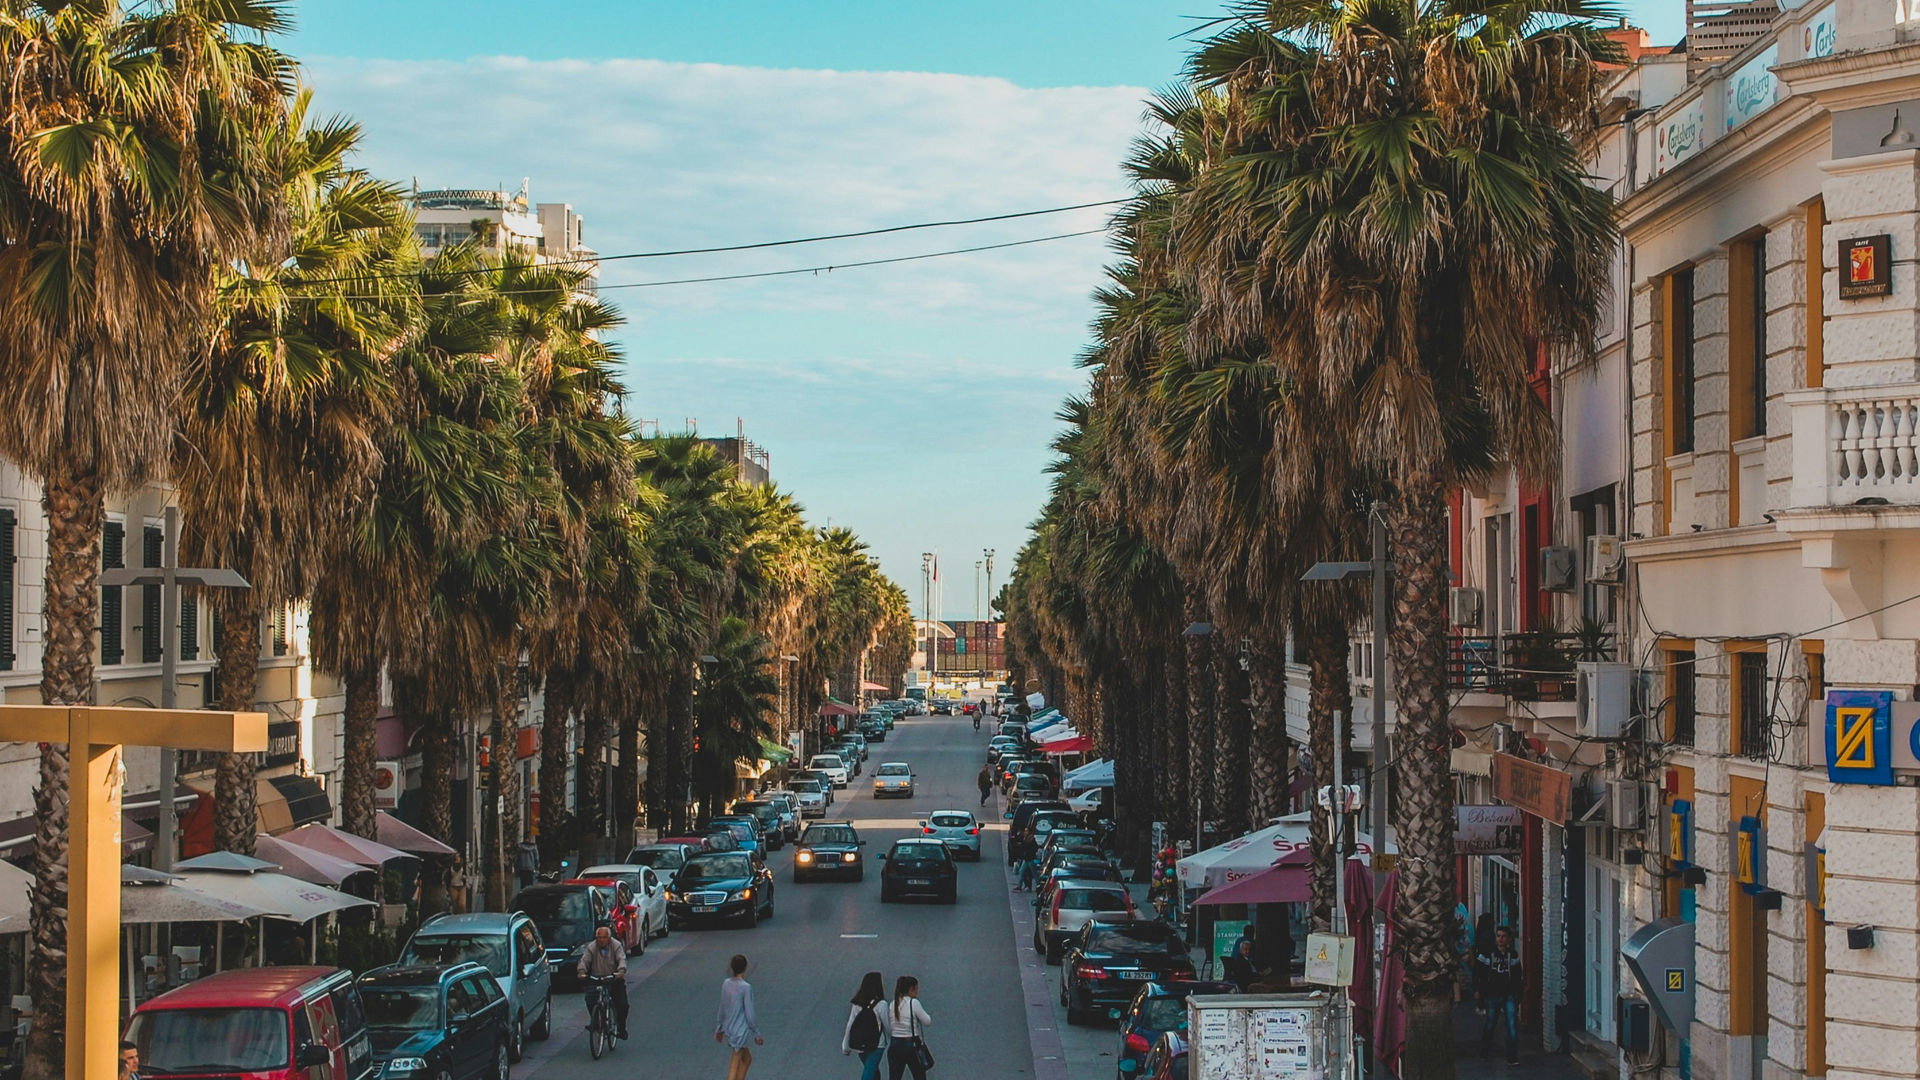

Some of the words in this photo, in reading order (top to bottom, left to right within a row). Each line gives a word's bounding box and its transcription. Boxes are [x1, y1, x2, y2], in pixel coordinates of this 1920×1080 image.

[1816, 21, 1836, 57] Carls
[1736, 68, 1770, 112] Carlsberg
[1668, 116, 1696, 156] Carlsberg
